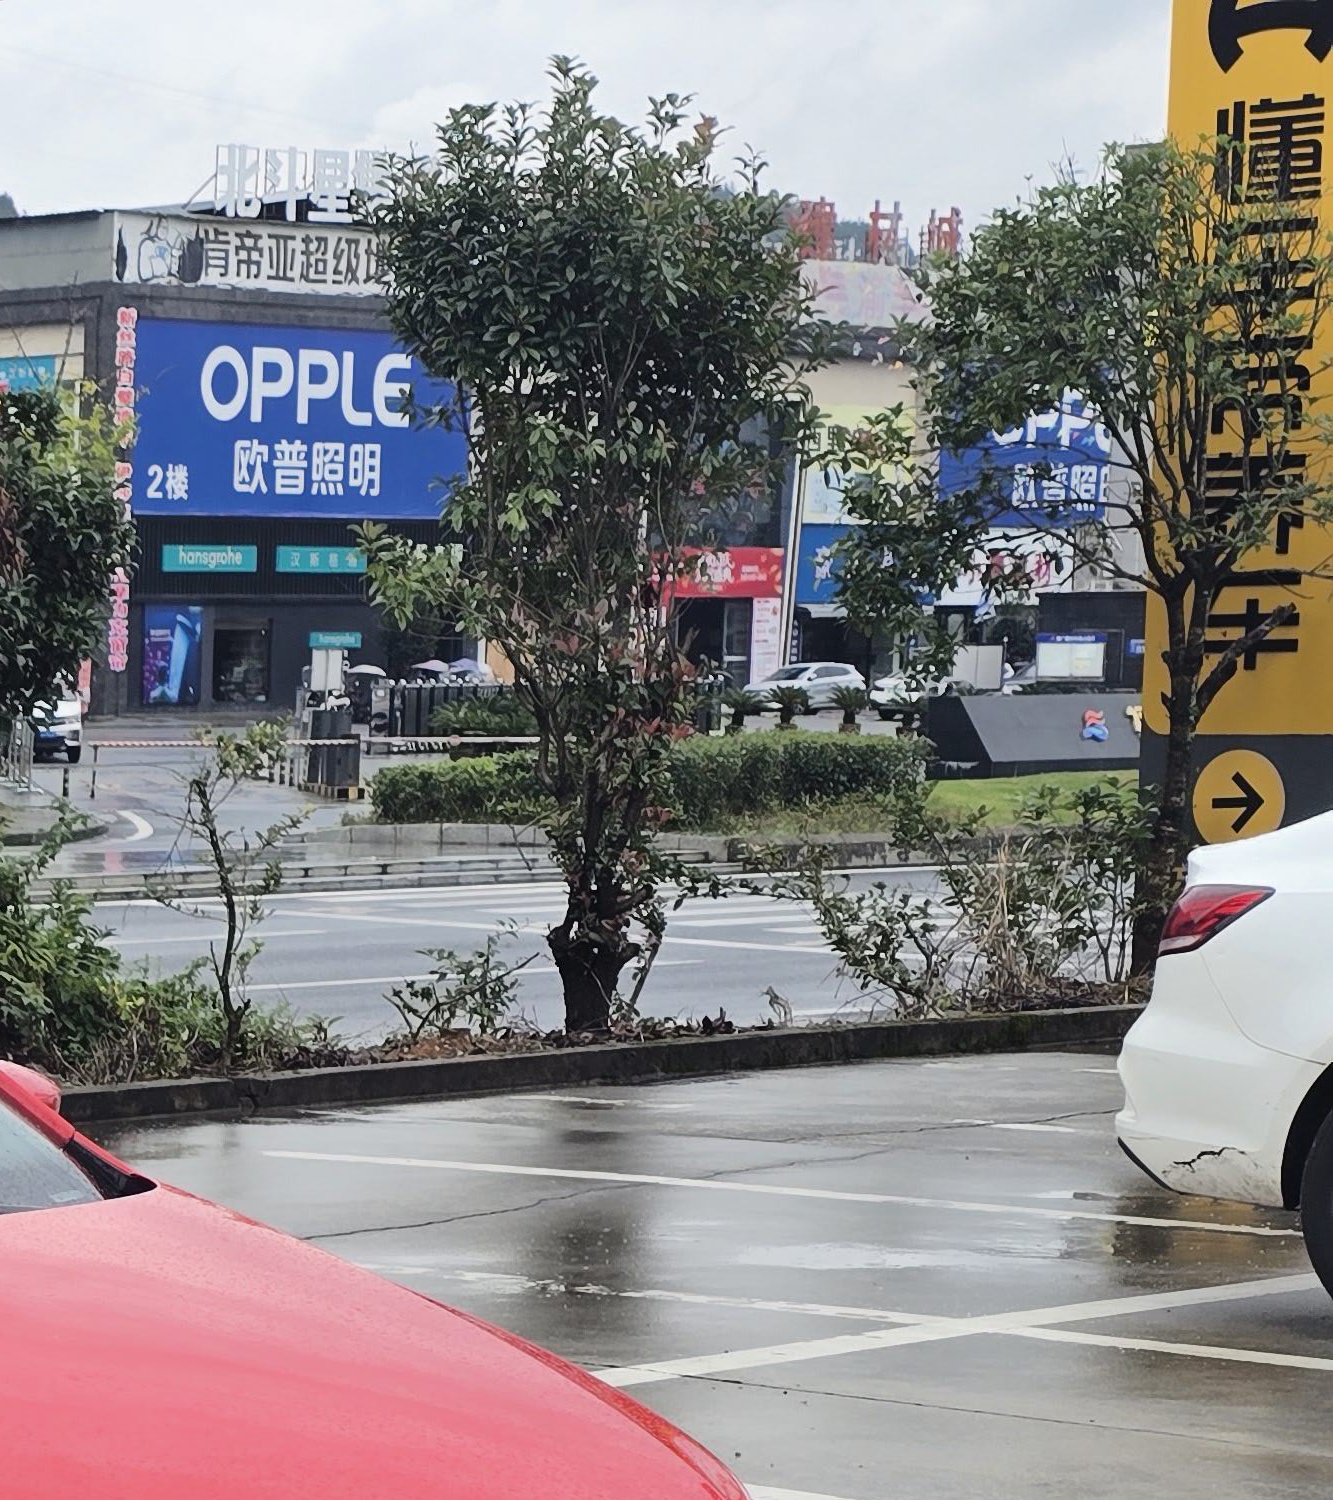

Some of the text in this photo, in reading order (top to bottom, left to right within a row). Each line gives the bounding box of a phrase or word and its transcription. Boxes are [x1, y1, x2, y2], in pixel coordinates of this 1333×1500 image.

[200, 345, 412, 428] OPPLE
[146, 463, 189, 501] 2楼
[233, 439, 382, 497] 欧普照明
[179, 546, 243, 569] hansgrohe
